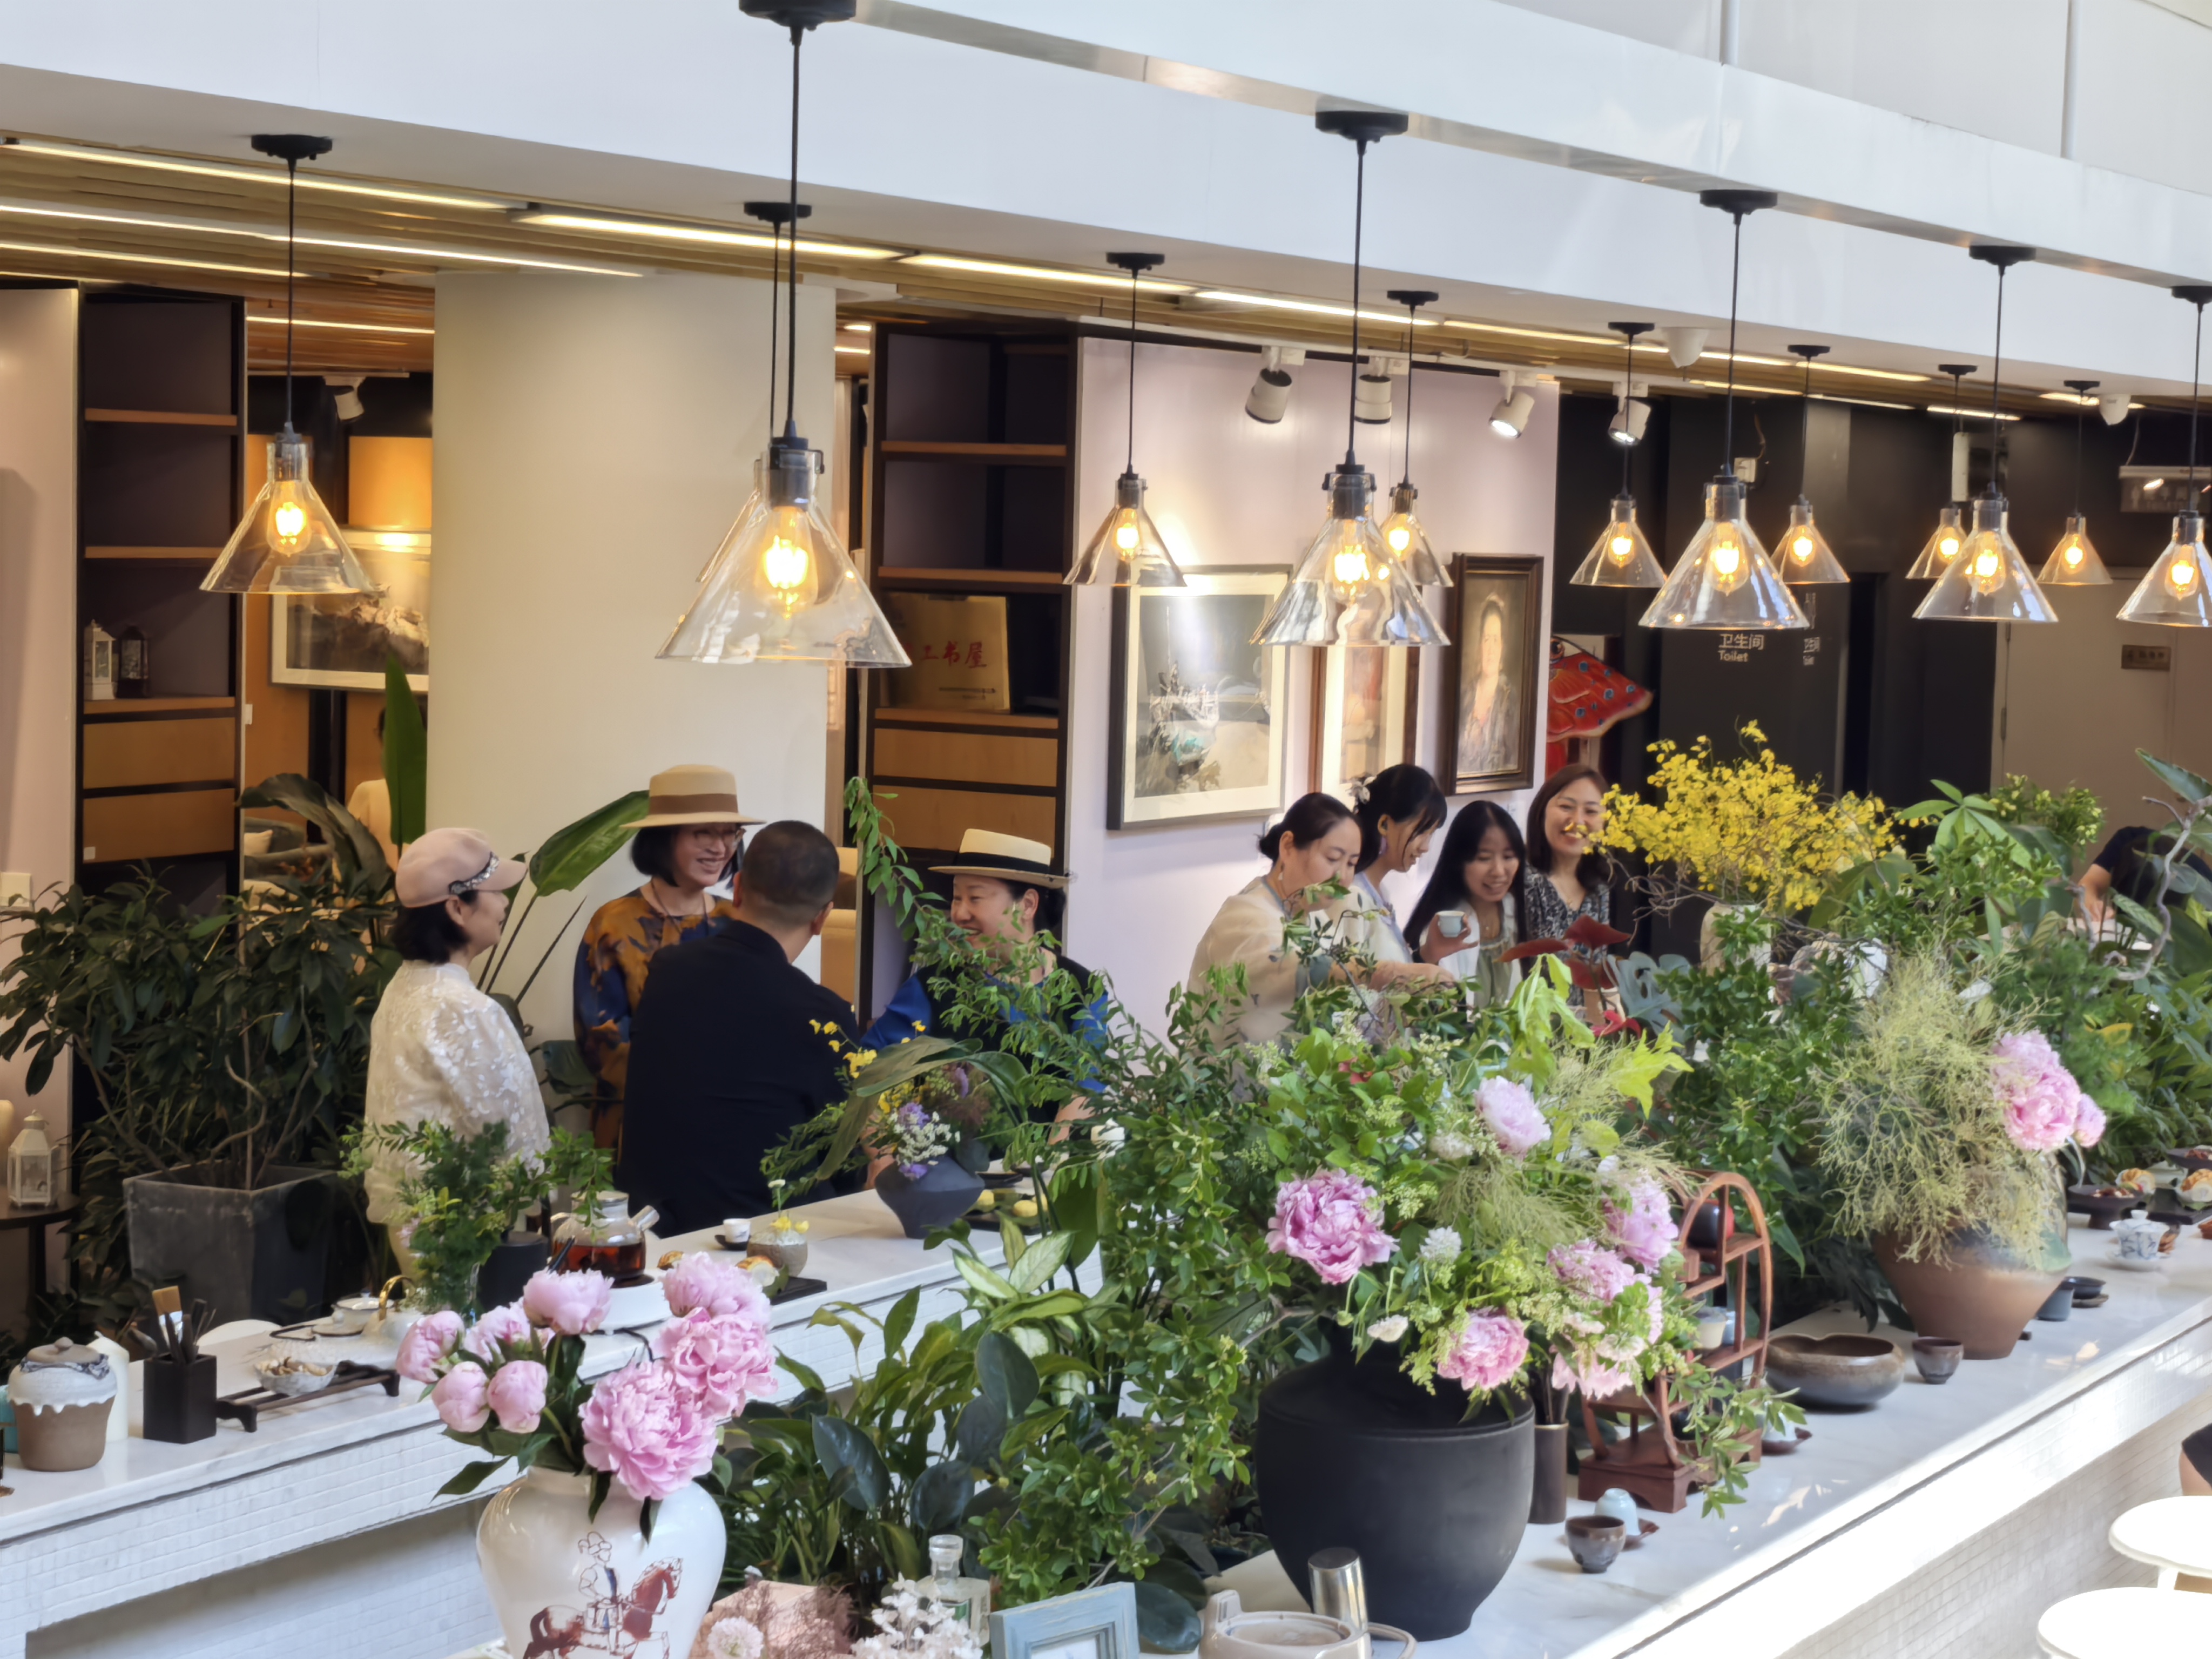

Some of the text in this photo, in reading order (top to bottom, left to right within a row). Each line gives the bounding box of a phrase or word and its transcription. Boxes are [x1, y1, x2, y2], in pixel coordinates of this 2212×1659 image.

[1718, 633, 1764, 650] 卫生间
[903, 640, 987, 668] 工书屋
[1718, 650, 1748, 662] Toilet
